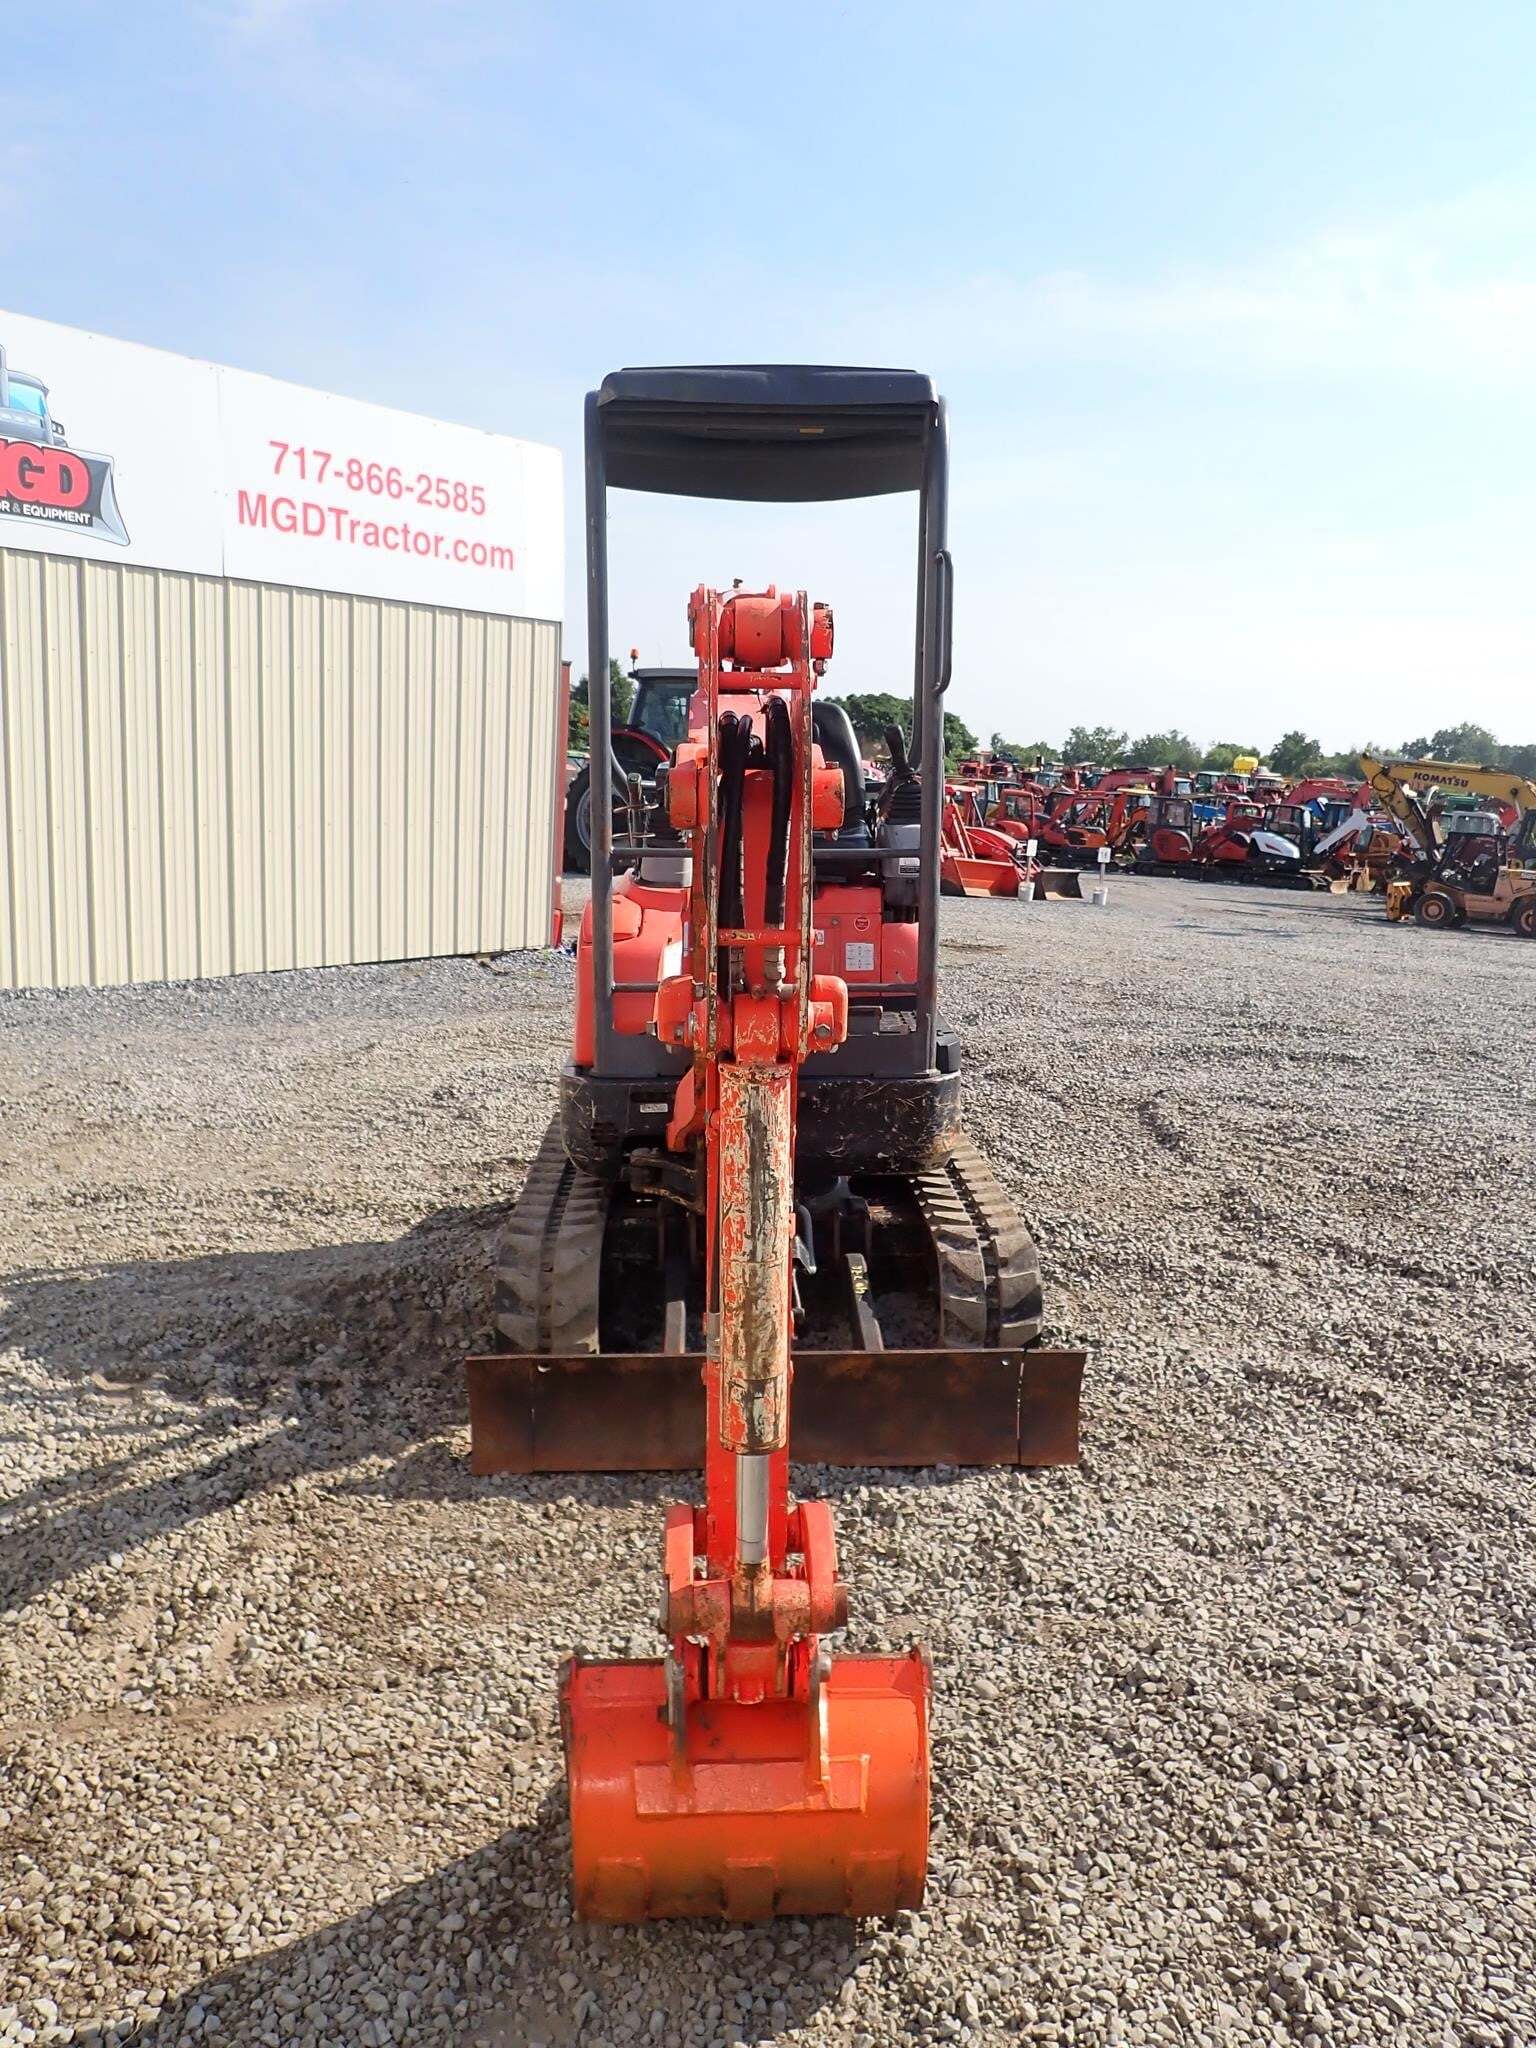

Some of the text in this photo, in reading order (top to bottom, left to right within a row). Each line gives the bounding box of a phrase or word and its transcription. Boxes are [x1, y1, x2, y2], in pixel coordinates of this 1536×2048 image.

[0, 438, 91, 508] GD
[269, 440, 487, 516] 717-866-2585
[23, 504, 91, 524] EQUIPMENT
[237, 490, 515, 570] MGDTractor.com
[1413, 772, 1469, 787] KOMATSU
